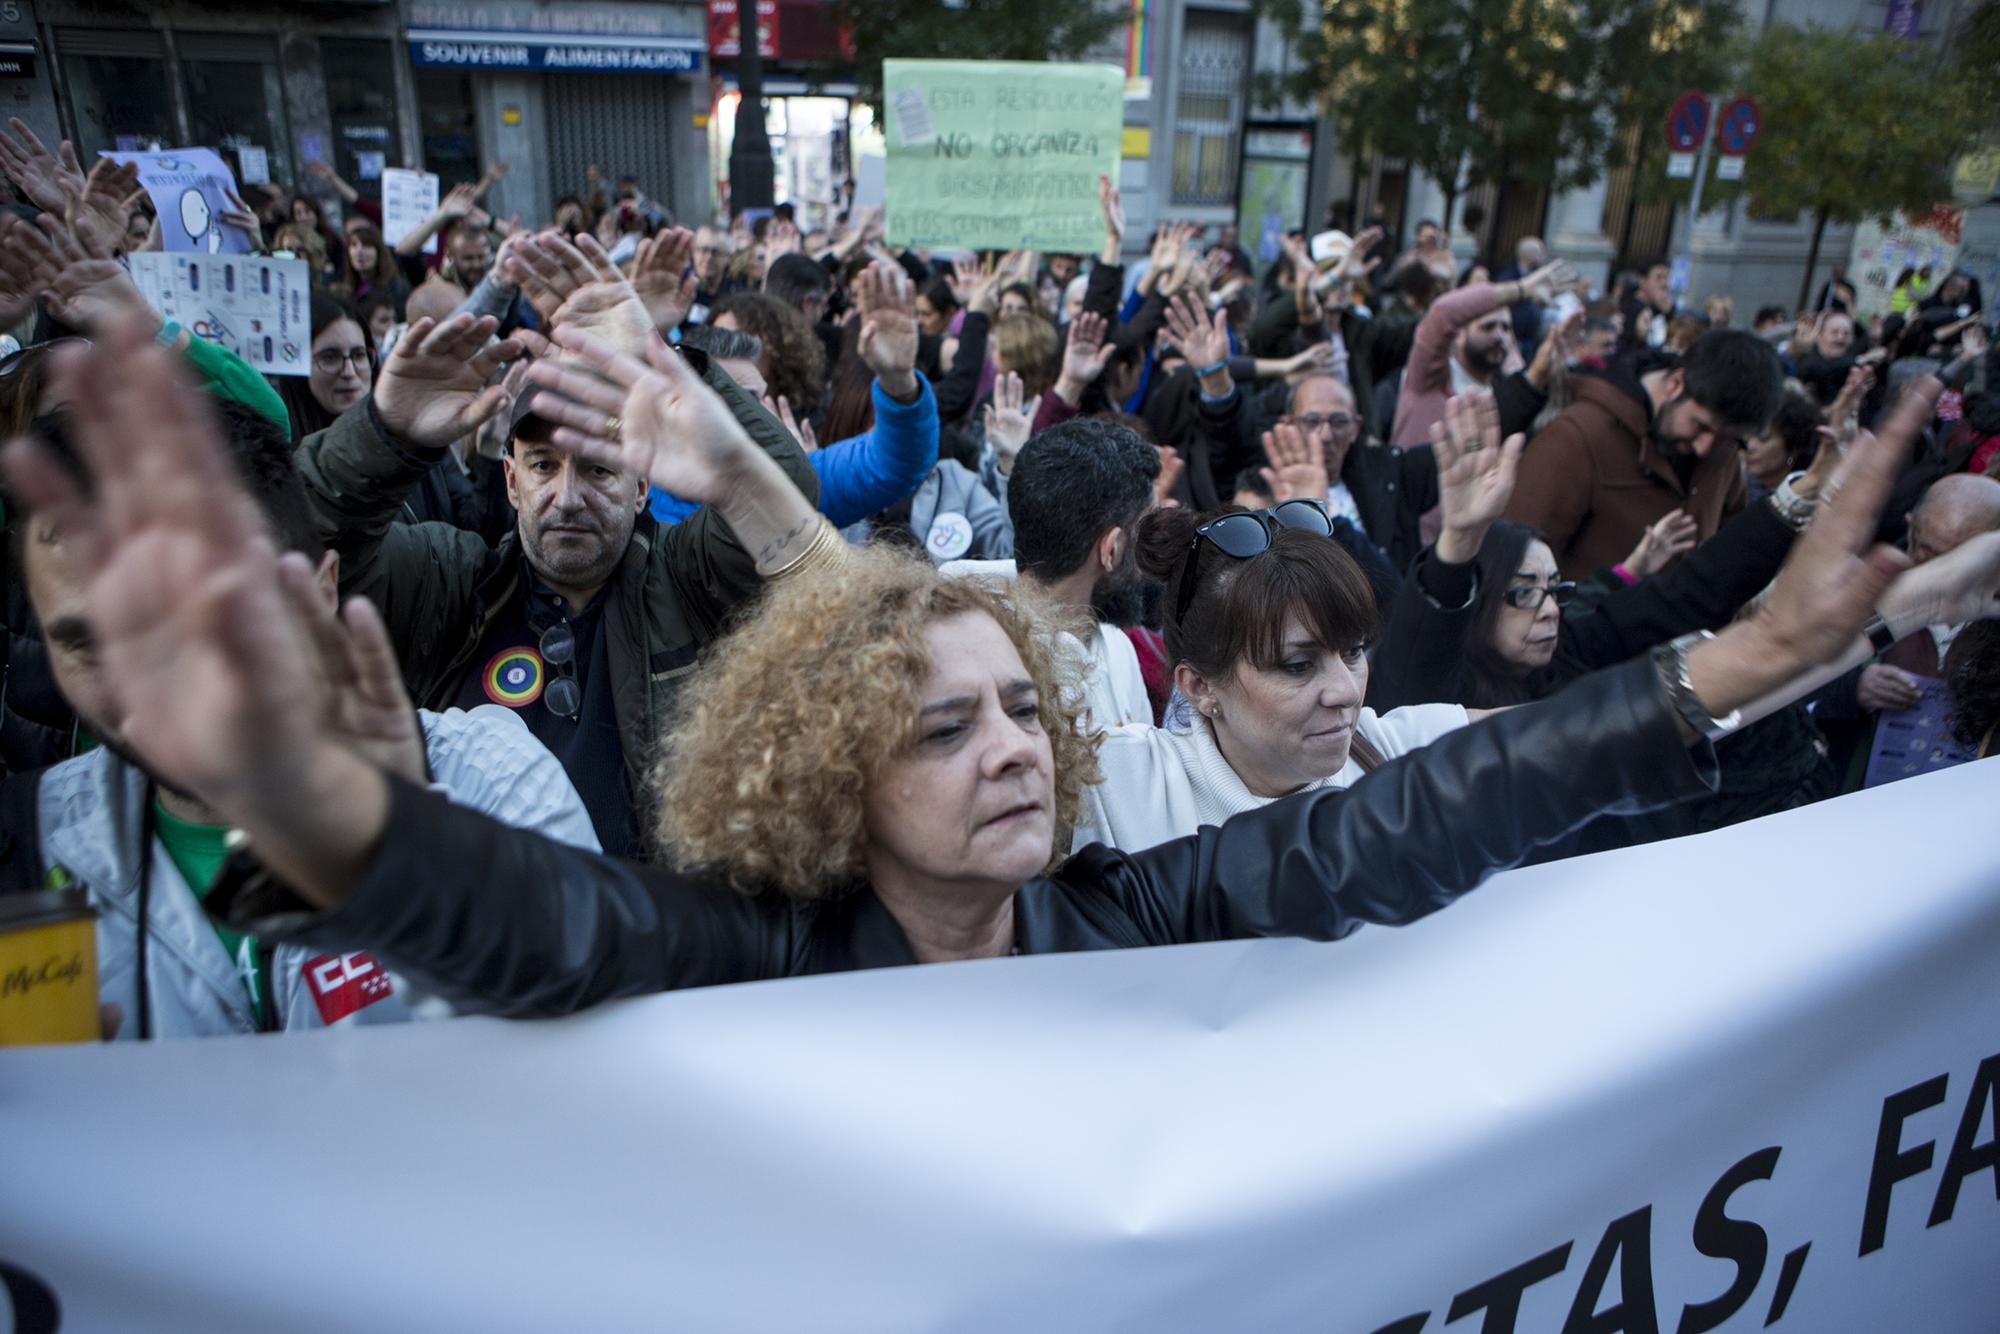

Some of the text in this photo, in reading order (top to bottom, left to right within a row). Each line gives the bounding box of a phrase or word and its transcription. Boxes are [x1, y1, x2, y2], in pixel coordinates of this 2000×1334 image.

[422, 43, 529, 66] SOUVENIR
[930, 87, 977, 111] ESTA
[934, 128, 1099, 159] NO ORGANIZA
[1368, 1146, 1813, 1334] TAS,
